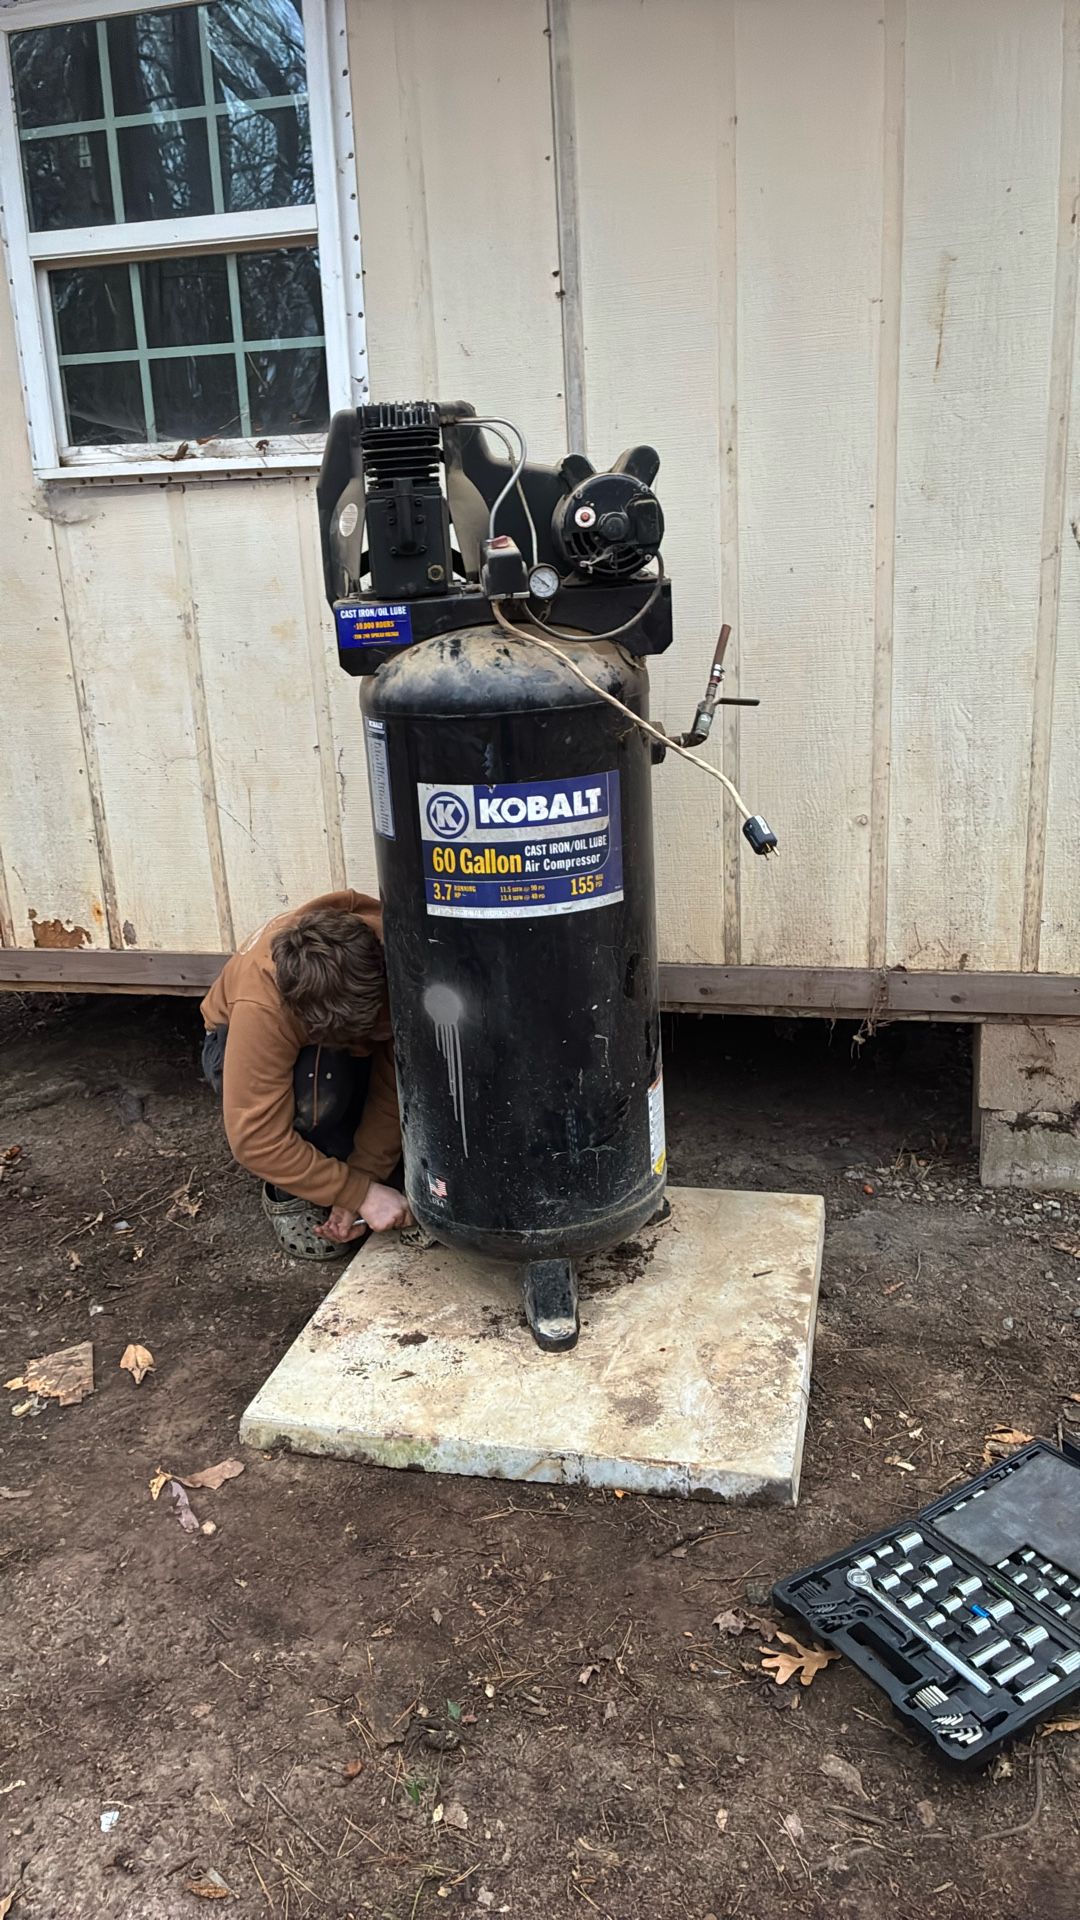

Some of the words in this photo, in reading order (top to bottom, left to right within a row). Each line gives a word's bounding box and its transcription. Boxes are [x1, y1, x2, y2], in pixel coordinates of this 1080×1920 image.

[340, 609, 357, 619] CAST
[358, 607, 389, 617] IRON/OIL
[390, 606, 407, 616] LUBE
[479, 787, 601, 824] KOBALT
[524, 844, 547, 857] CAST
[549, 839, 588, 855] IRON/OIL
[589, 835, 608, 849] LUBE
[432, 847, 456, 873] 60
[460, 848, 522, 874] Gallon
[525, 860, 540, 873] Air
[543, 854, 601, 871] Compressor
[433, 882, 452, 900] 3.7
[571, 875, 595, 896] 155
[432, 1197, 445, 1209] USA
